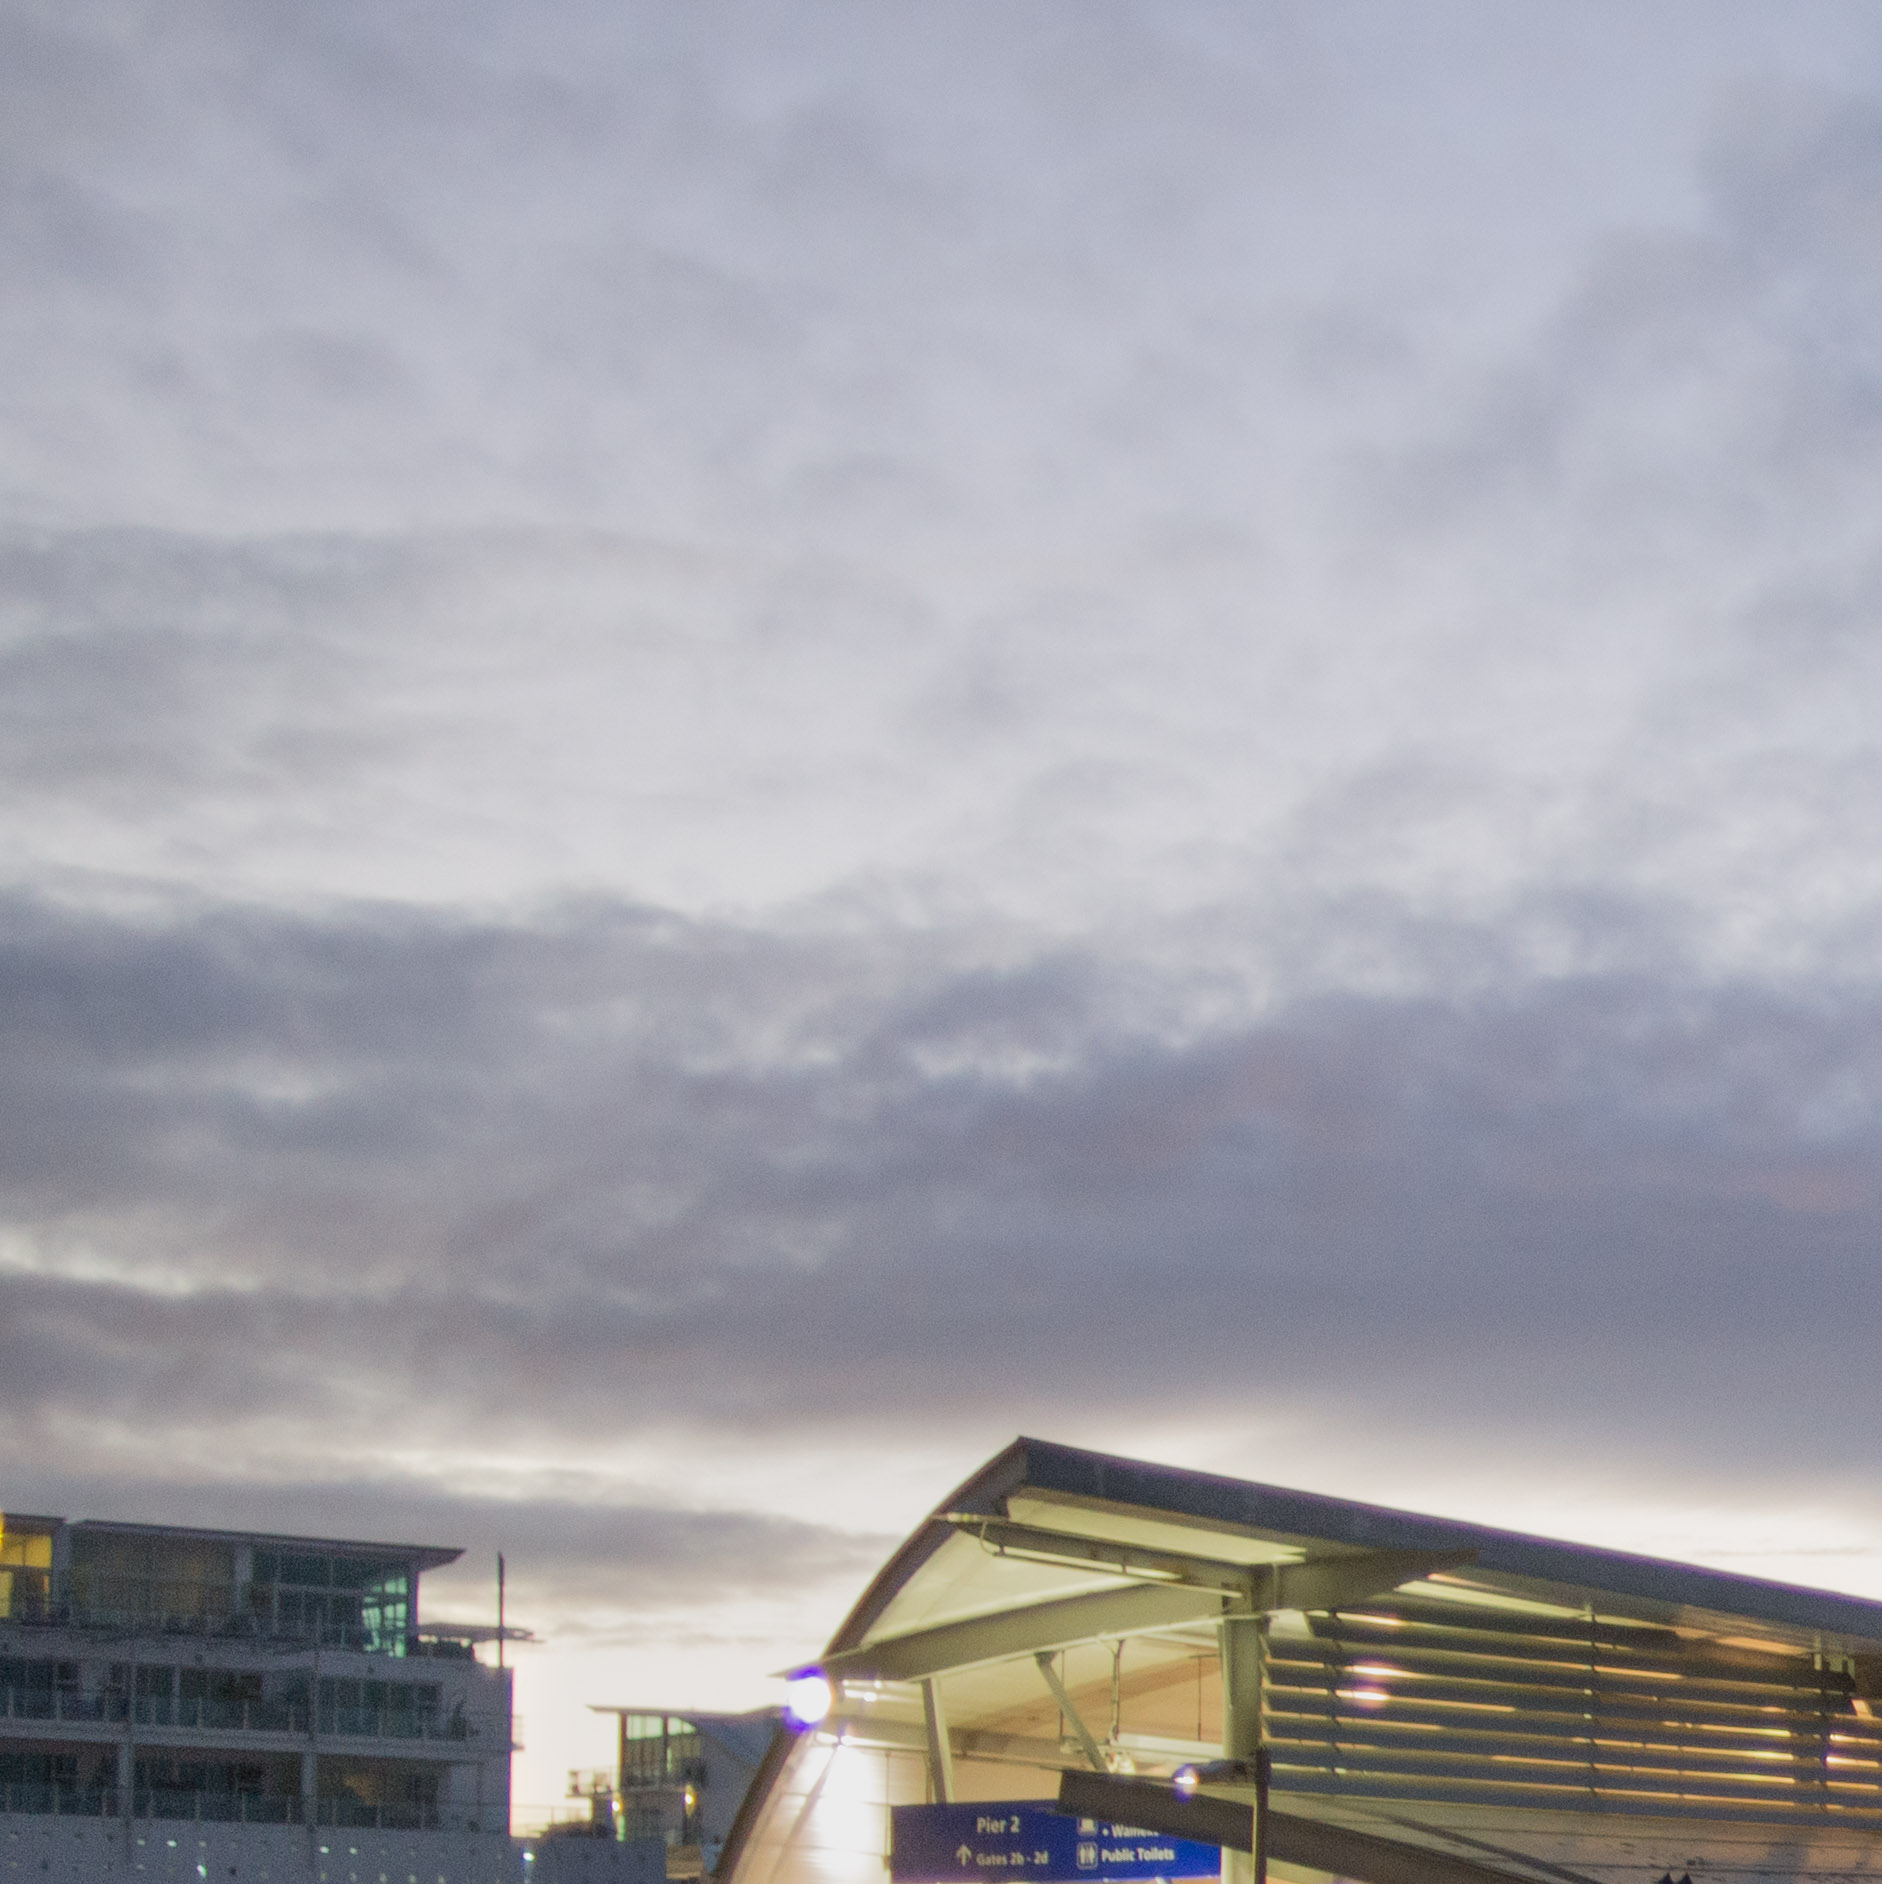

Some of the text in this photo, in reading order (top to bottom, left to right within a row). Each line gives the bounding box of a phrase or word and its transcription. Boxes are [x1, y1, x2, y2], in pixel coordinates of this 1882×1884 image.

[977, 1815, 1020, 1833] Pier 2
[977, 1853, 1007, 1866] Gates
[1102, 1847, 1175, 1862] Public Toilets
